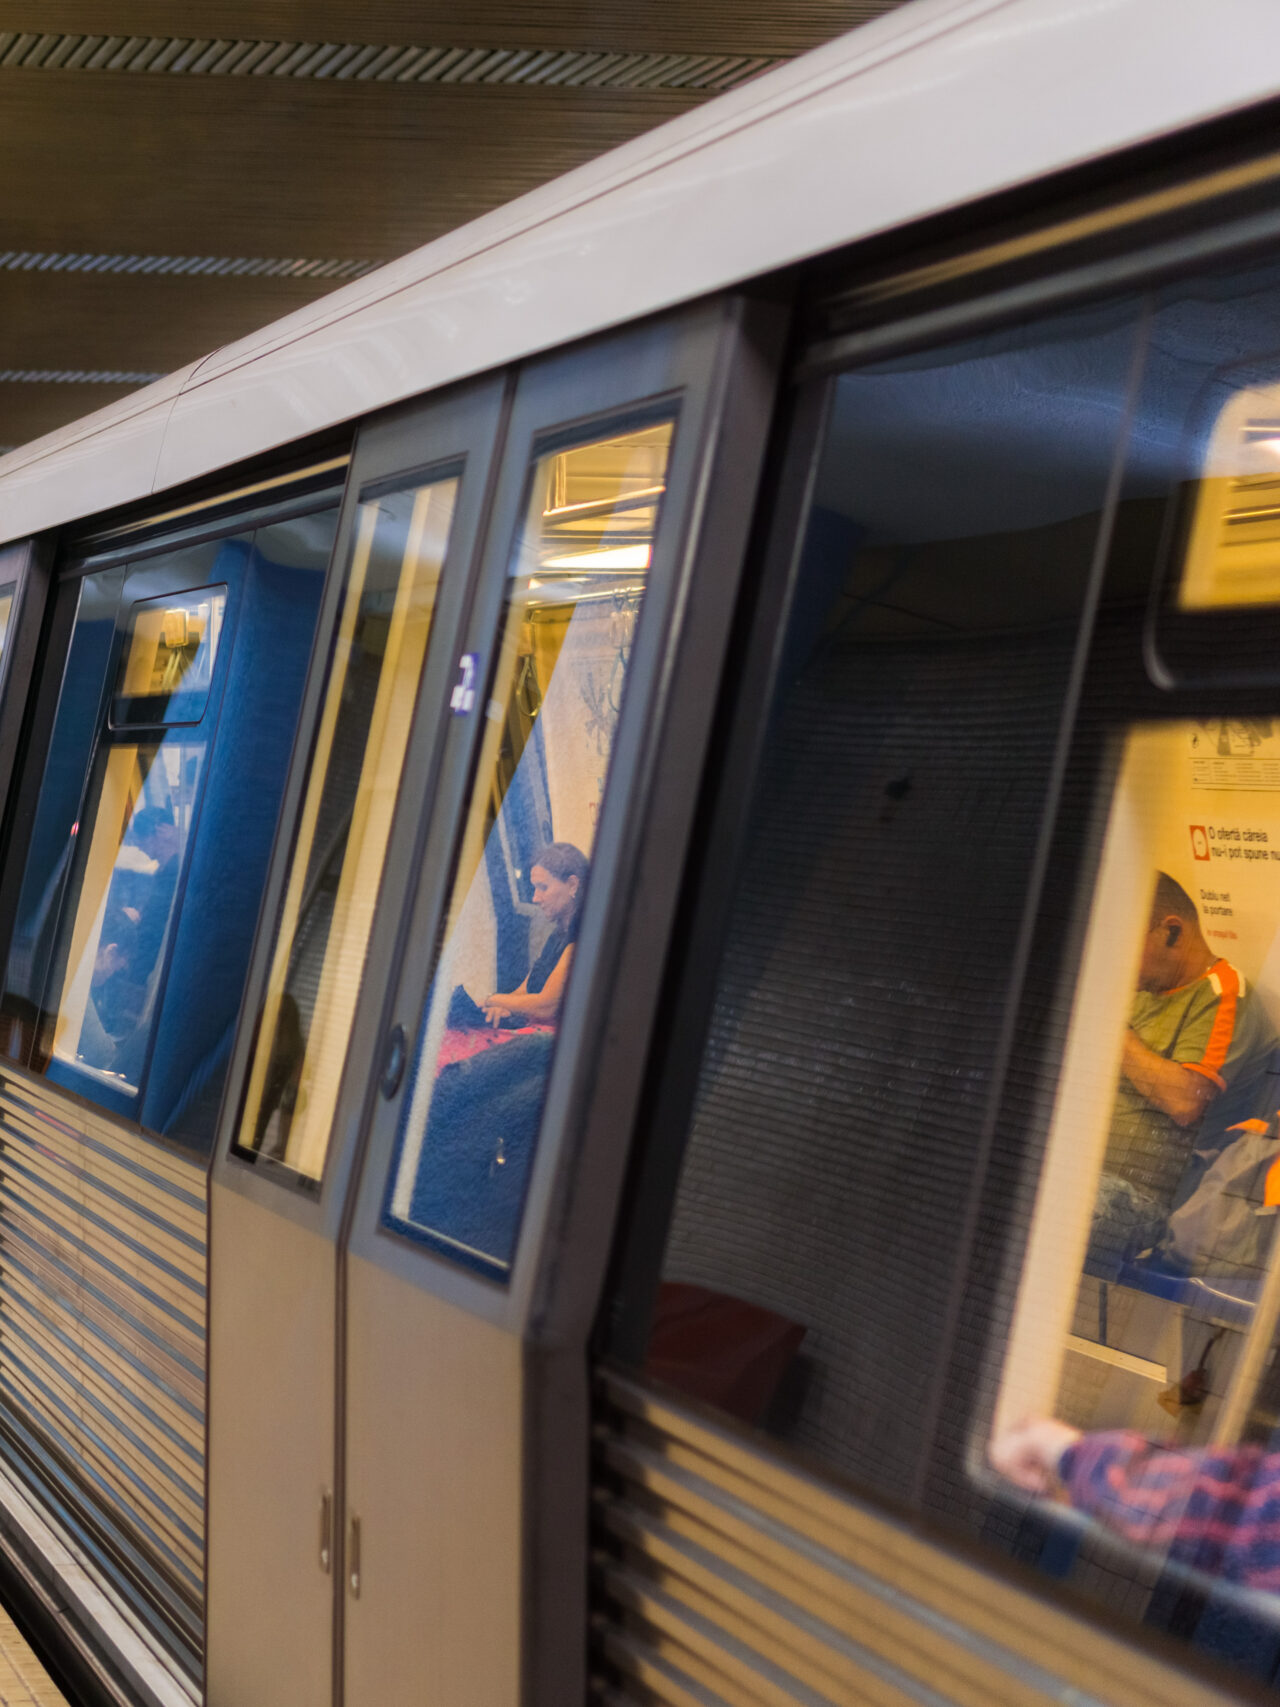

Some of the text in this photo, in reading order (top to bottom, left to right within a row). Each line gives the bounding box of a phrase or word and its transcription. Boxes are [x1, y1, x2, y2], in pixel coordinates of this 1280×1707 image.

[1208, 826, 1216, 840] O
[1211, 844, 1227, 857] nu-i
[1228, 846, 1242, 860] pot
[1243, 848, 1269, 862] spune
